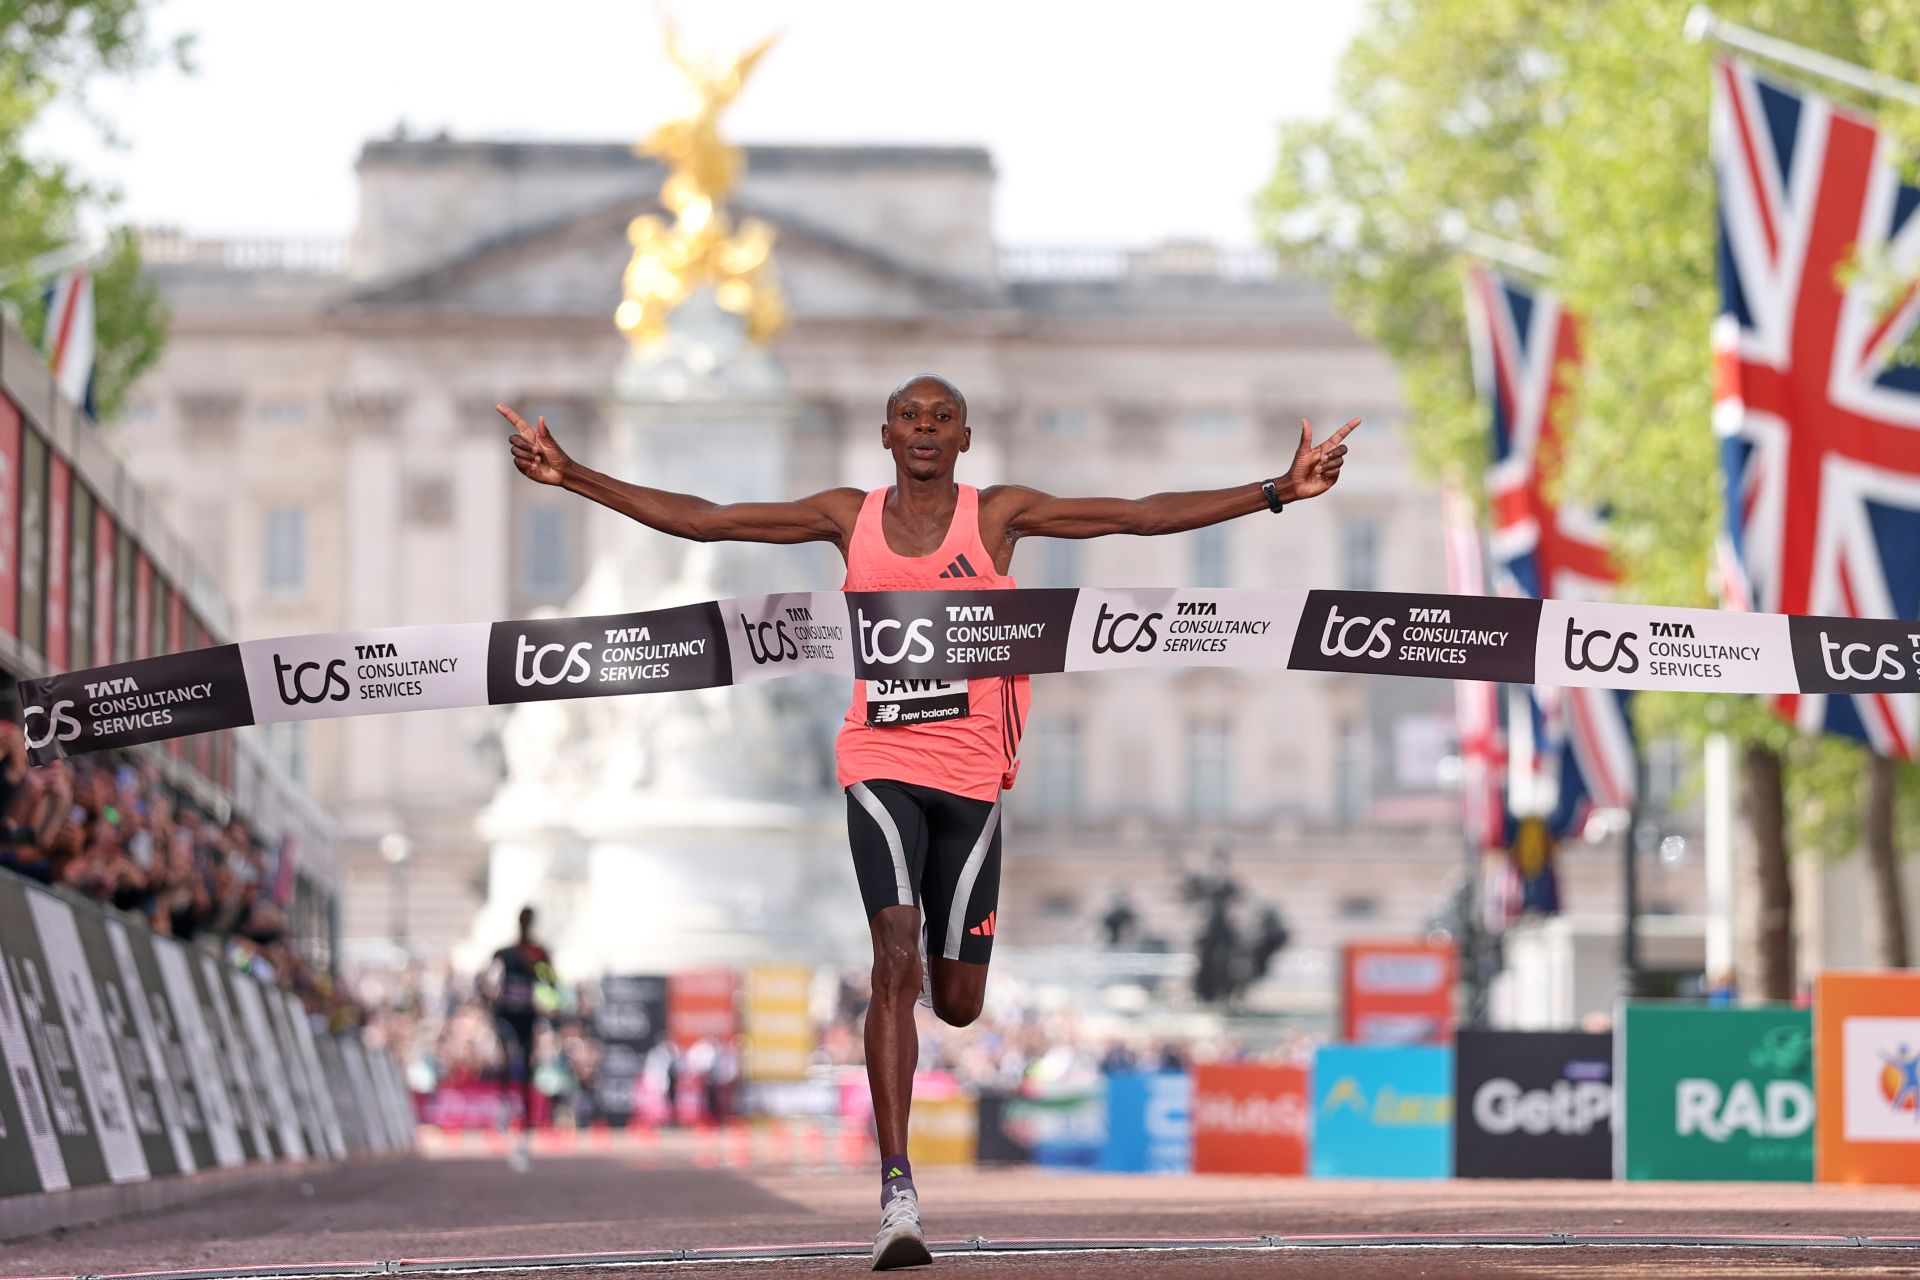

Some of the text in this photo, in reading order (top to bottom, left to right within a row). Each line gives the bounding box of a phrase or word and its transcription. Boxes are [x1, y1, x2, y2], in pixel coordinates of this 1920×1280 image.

[786, 608, 812, 621] TATA
[946, 606, 994, 621] TATA
[1178, 603, 1216, 615] TATA
[1409, 608, 1450, 623] TATA
[605, 627, 650, 643] TATA
[794, 626, 842, 640] CONSULTANCY
[858, 609, 934, 664] tcs
[946, 623, 1045, 642] CONSULTANCY
[1092, 603, 1166, 654] tcs
[1170, 621, 1271, 634] CONSULTANCY
[1321, 605, 1395, 658] tcs
[1403, 627, 1508, 646] CONSULTANCY
[1650, 622, 1694, 638] TATA
[741, 614, 798, 664] tcs
[1163, 639, 1227, 651] SERVICES
[1565, 617, 1639, 673] tcs
[355, 644, 397, 659] TATA
[602, 639, 705, 664] CONSULTANCY
[802, 644, 834, 659] SERVICES
[947, 646, 1010, 663] SERVICES
[1399, 646, 1466, 663] SERVICES
[1649, 642, 1760, 660] CONSULTANCY
[1820, 632, 1905, 680] tcs
[358, 658, 457, 679] CONSULTANCY
[516, 635, 592, 686] tcs
[1650, 662, 1721, 677] SERVICES
[273, 654, 350, 705] tcs
[600, 664, 669, 681] SERVICES
[84, 677, 139, 698] TATA
[360, 681, 422, 699] SERVICES
[89, 683, 211, 716] CONSULTANCY
[93, 709, 172, 736] SERVICES
[902, 712, 920, 720] new
[921, 707, 960, 718] balance
[23, 700, 82, 750] cs
[1676, 1078, 1814, 1142] RAD
